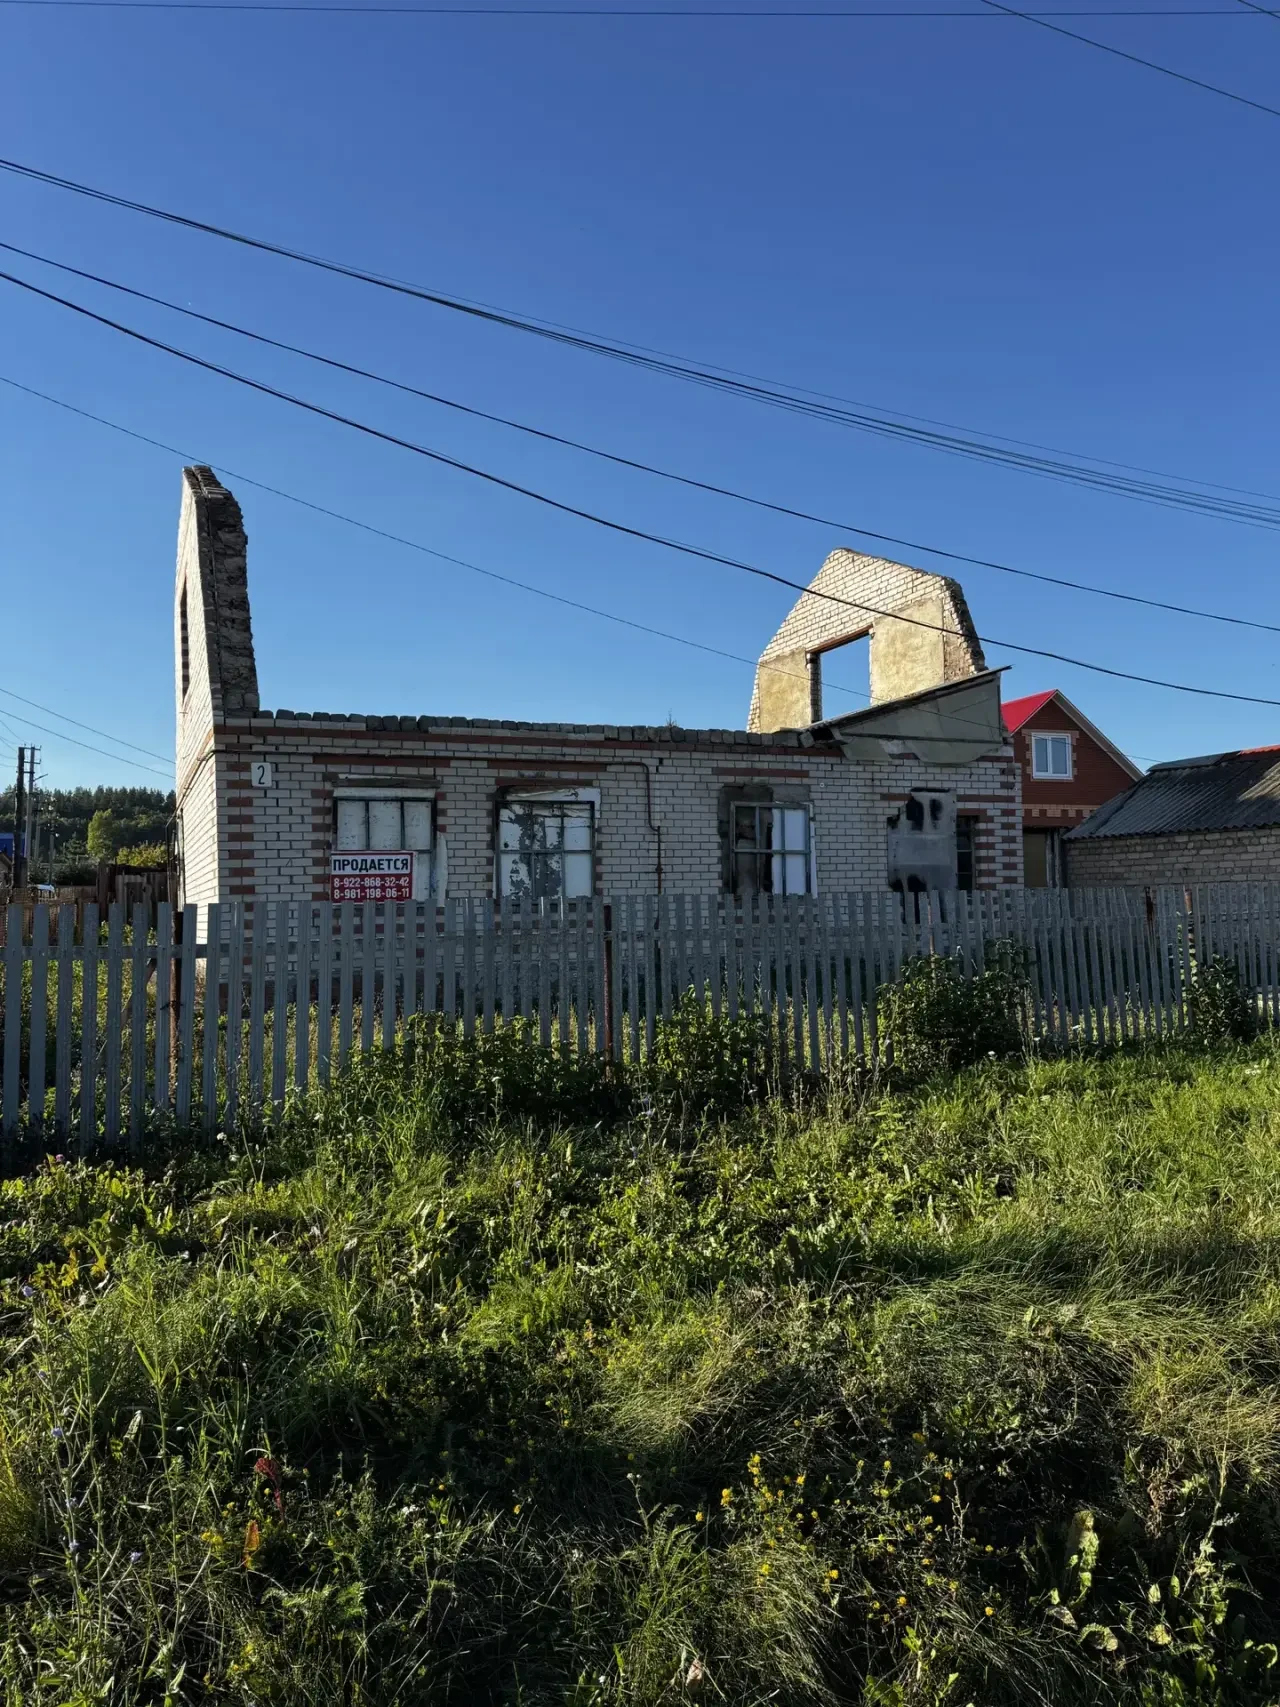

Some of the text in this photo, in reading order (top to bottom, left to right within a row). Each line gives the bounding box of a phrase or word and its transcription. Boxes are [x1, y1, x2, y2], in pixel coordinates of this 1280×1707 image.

[257, 764, 265, 785] 2
[333, 858, 409, 873] ПРОДАЕТСЯ
[333, 876, 410, 888] 8-922-868-32-42
[333, 887, 410, 899] 8-981-198-06-11
